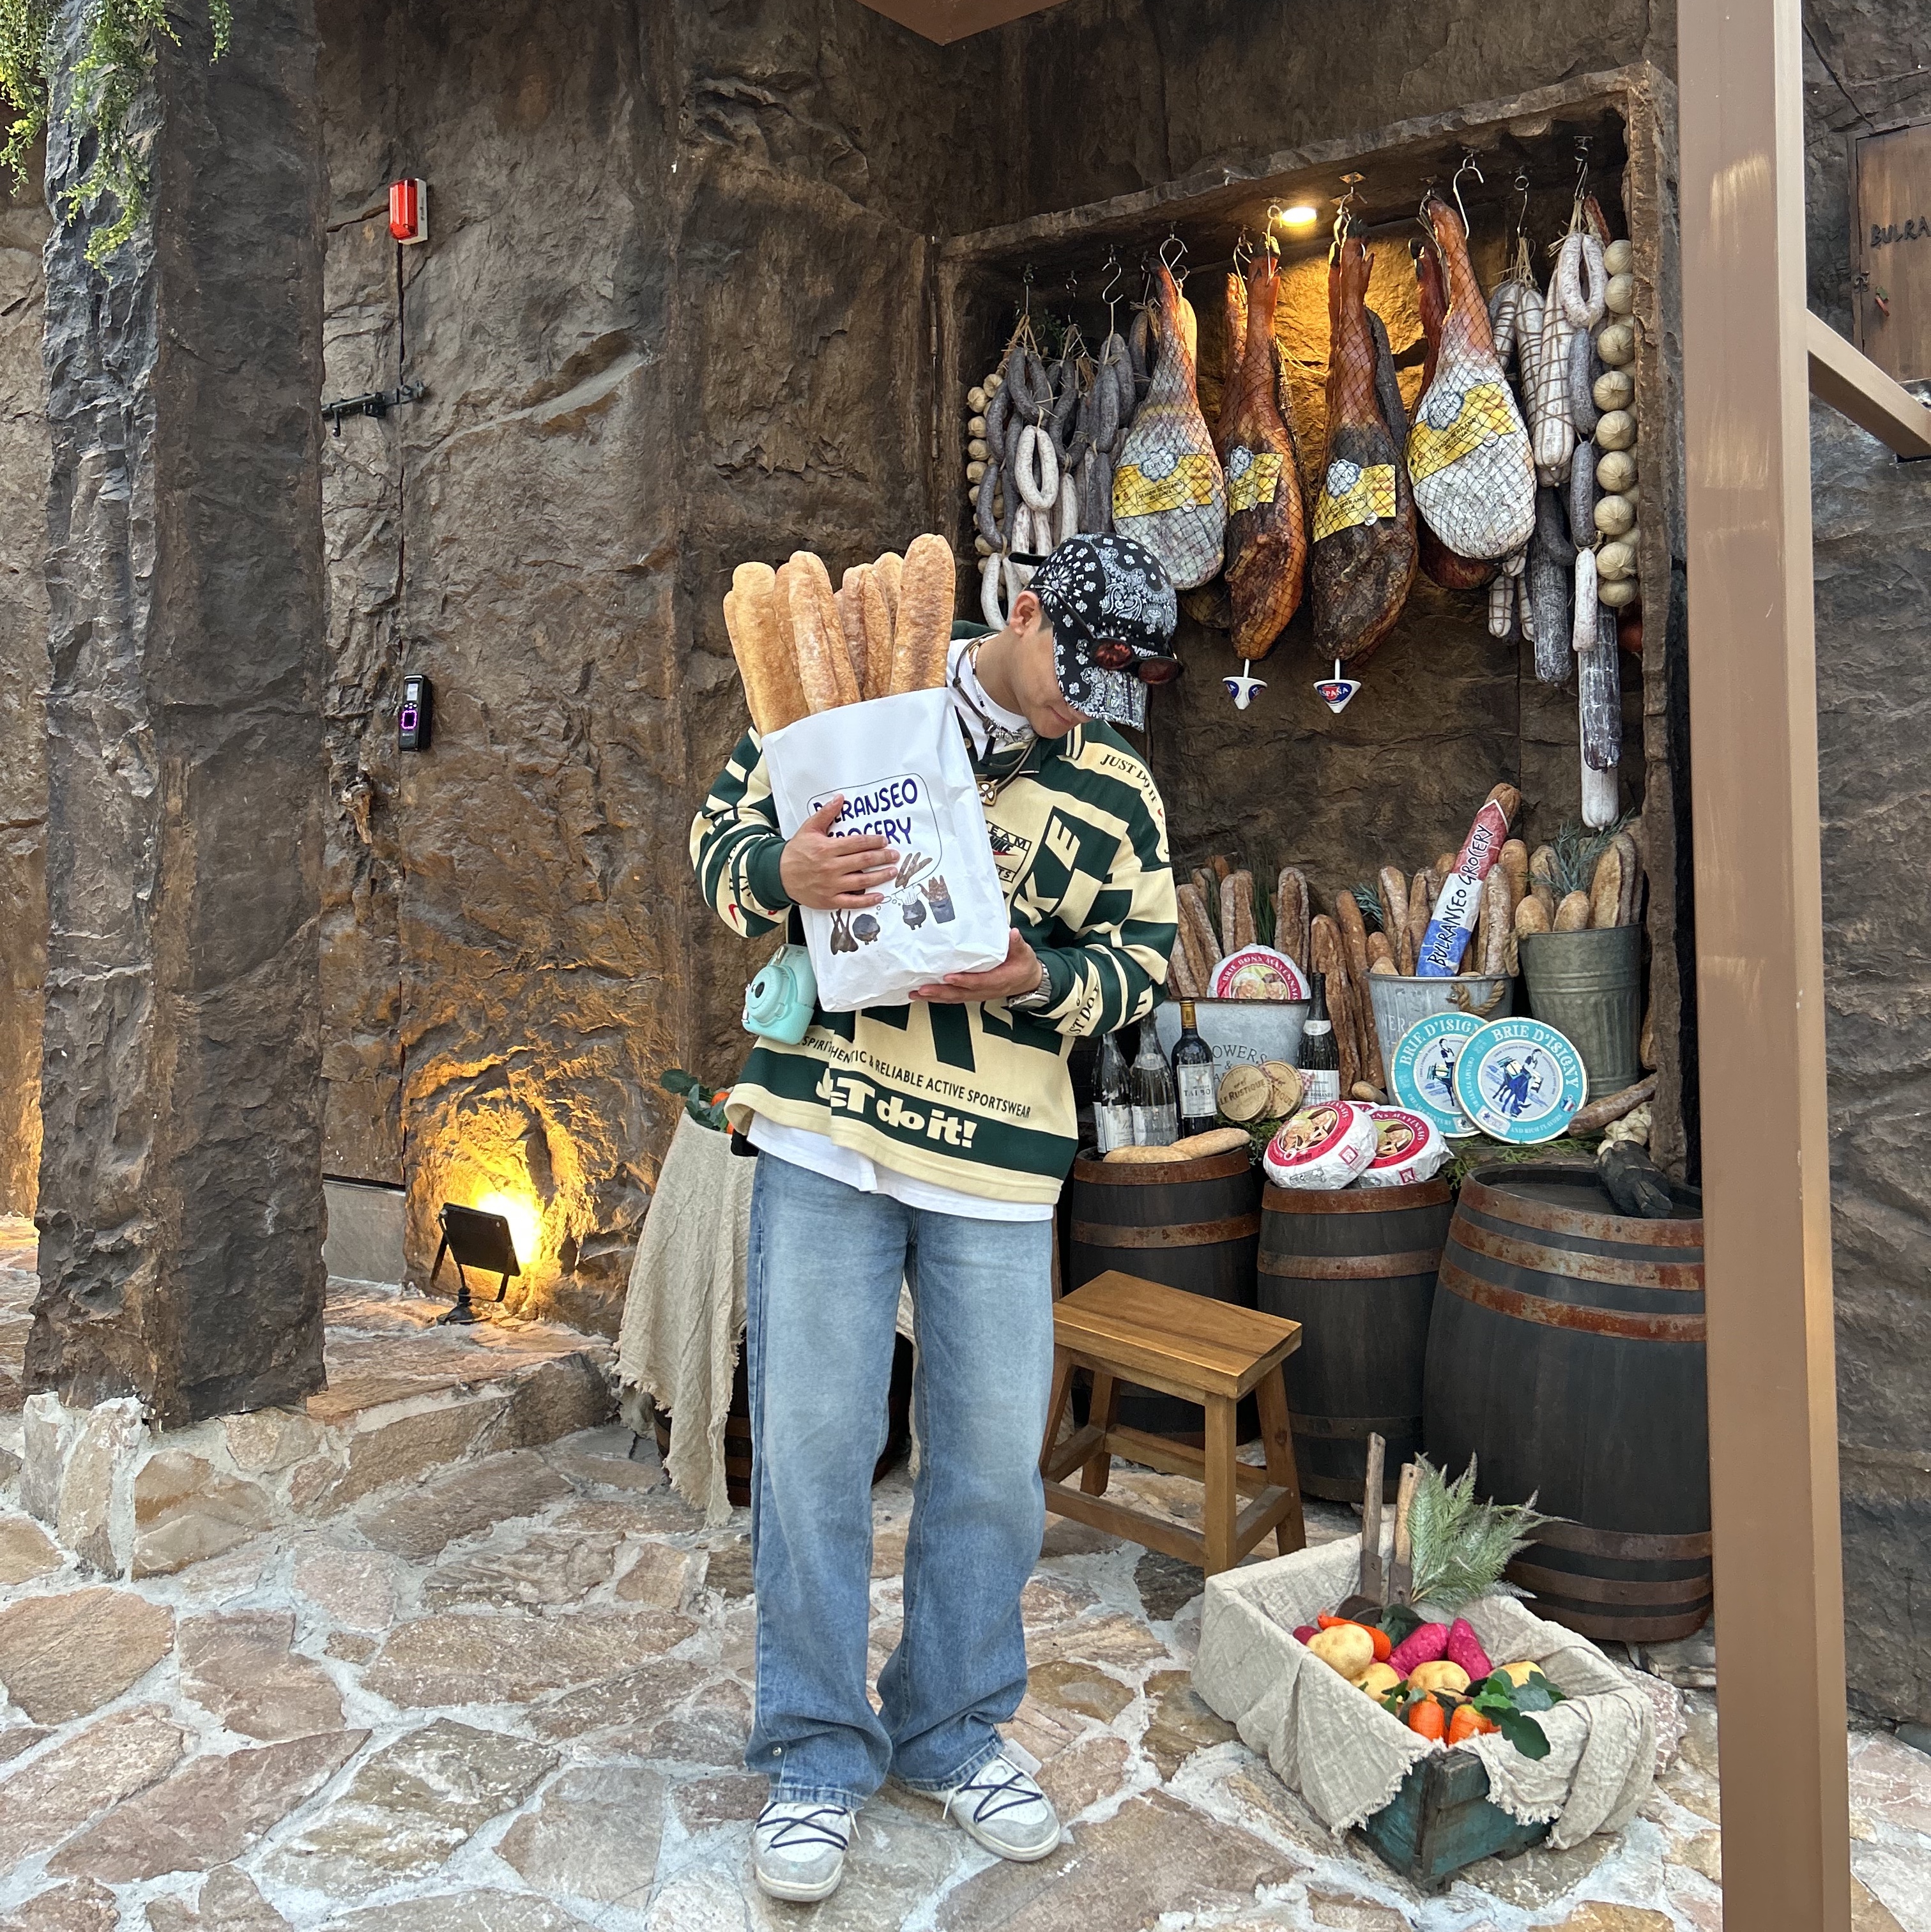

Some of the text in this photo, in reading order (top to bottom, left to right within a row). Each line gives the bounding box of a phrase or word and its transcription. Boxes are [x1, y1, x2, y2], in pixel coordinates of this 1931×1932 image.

[813, 778, 918, 824] RANSEO
[1100, 754, 1157, 803] JUST DO IT
[988, 824, 1028, 849] EAM
[1014, 815, 1081, 927] KE
[1427, 825, 1493, 966] BULRANSEO GROCERY
[1223, 965, 1237, 981] BRIE
[1080, 997, 1095, 1022] DO
[1212, 1044, 1267, 1065] OWERS
[1400, 1032, 1426, 1065] BRIE
[1492, 1024, 1529, 1042] BRIE
[1532, 1028, 1579, 1088] D'ISIGNY
[876, 1059, 922, 1087] RELIABLE
[926, 1077, 965, 1099] ACTIVE
[966, 1090, 1031, 1118] SPORTSWEAR
[1228, 1079, 1265, 1100] RUSTIQUE
[876, 1096, 925, 1130] do
[926, 1109, 977, 1148] it!
